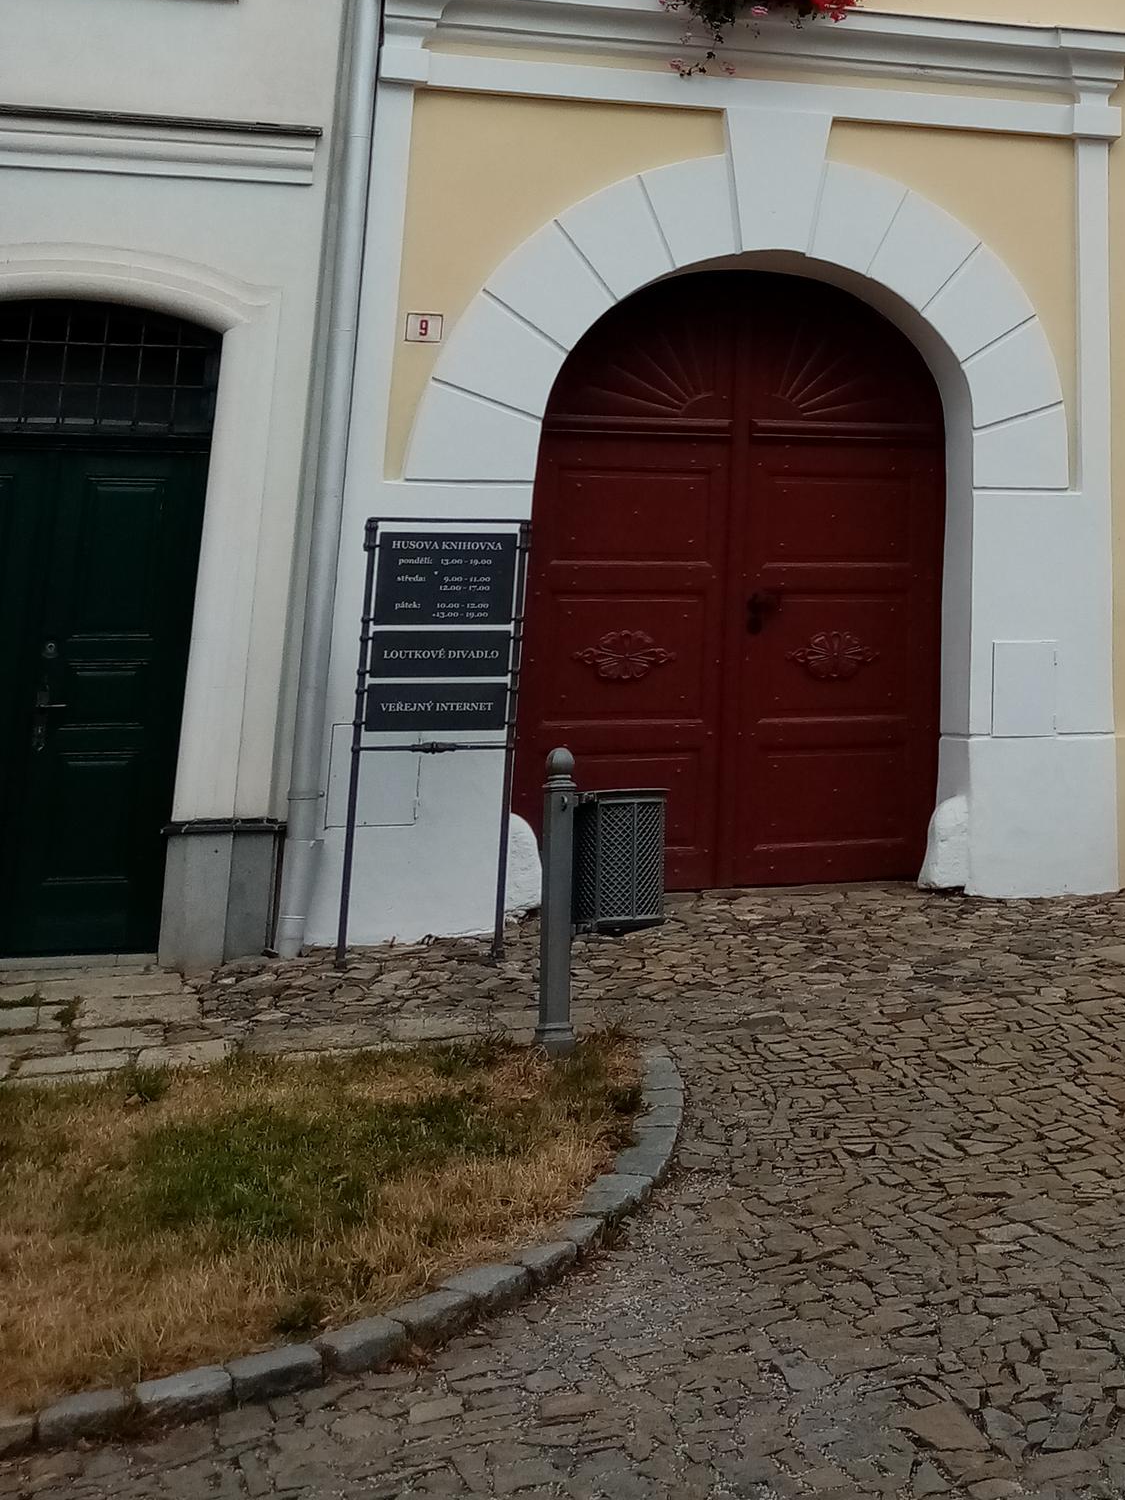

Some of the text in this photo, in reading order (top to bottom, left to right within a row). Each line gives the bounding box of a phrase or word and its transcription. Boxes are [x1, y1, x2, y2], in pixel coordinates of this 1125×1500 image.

[419, 319, 429, 336] 9
[392, 541, 503, 550] HUSOVA KNIHOVNA
[395, 601, 421, 610] pátek:
[384, 648, 499, 659] LOUTKOVÉ DIVADLO
[380, 701, 494, 711] VEŘEJNÝ INTERNET
